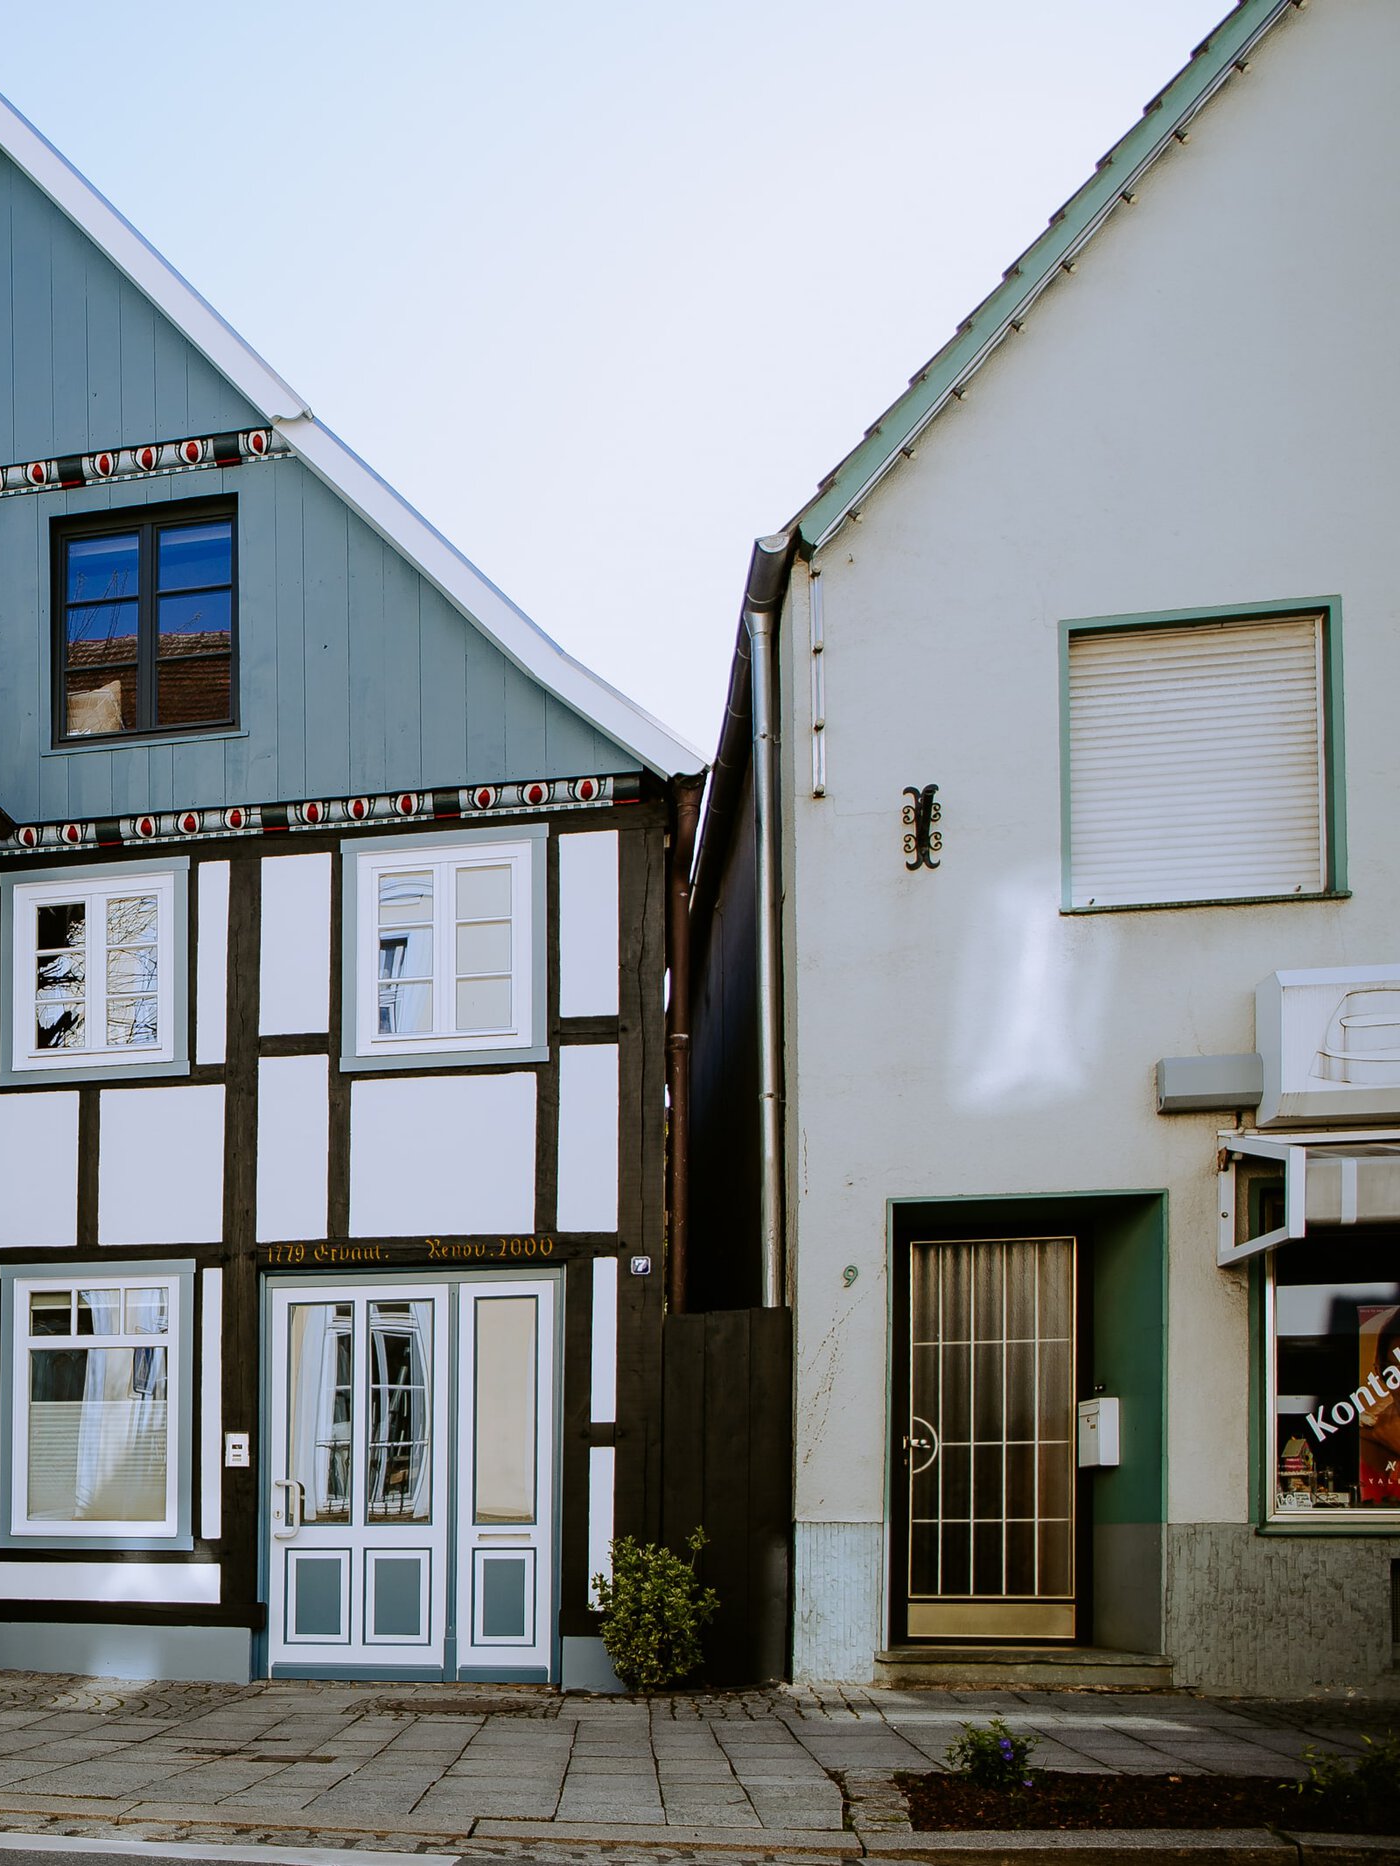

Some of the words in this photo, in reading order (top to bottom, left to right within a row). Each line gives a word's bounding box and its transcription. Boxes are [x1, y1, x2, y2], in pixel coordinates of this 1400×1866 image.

[267, 1244, 305, 1263] 1779
[425, 1239, 494, 1259] Renov.
[498, 1237, 554, 1257] 2000
[634, 1258, 647, 1272] 7
[843, 1265, 858, 1288] 9
